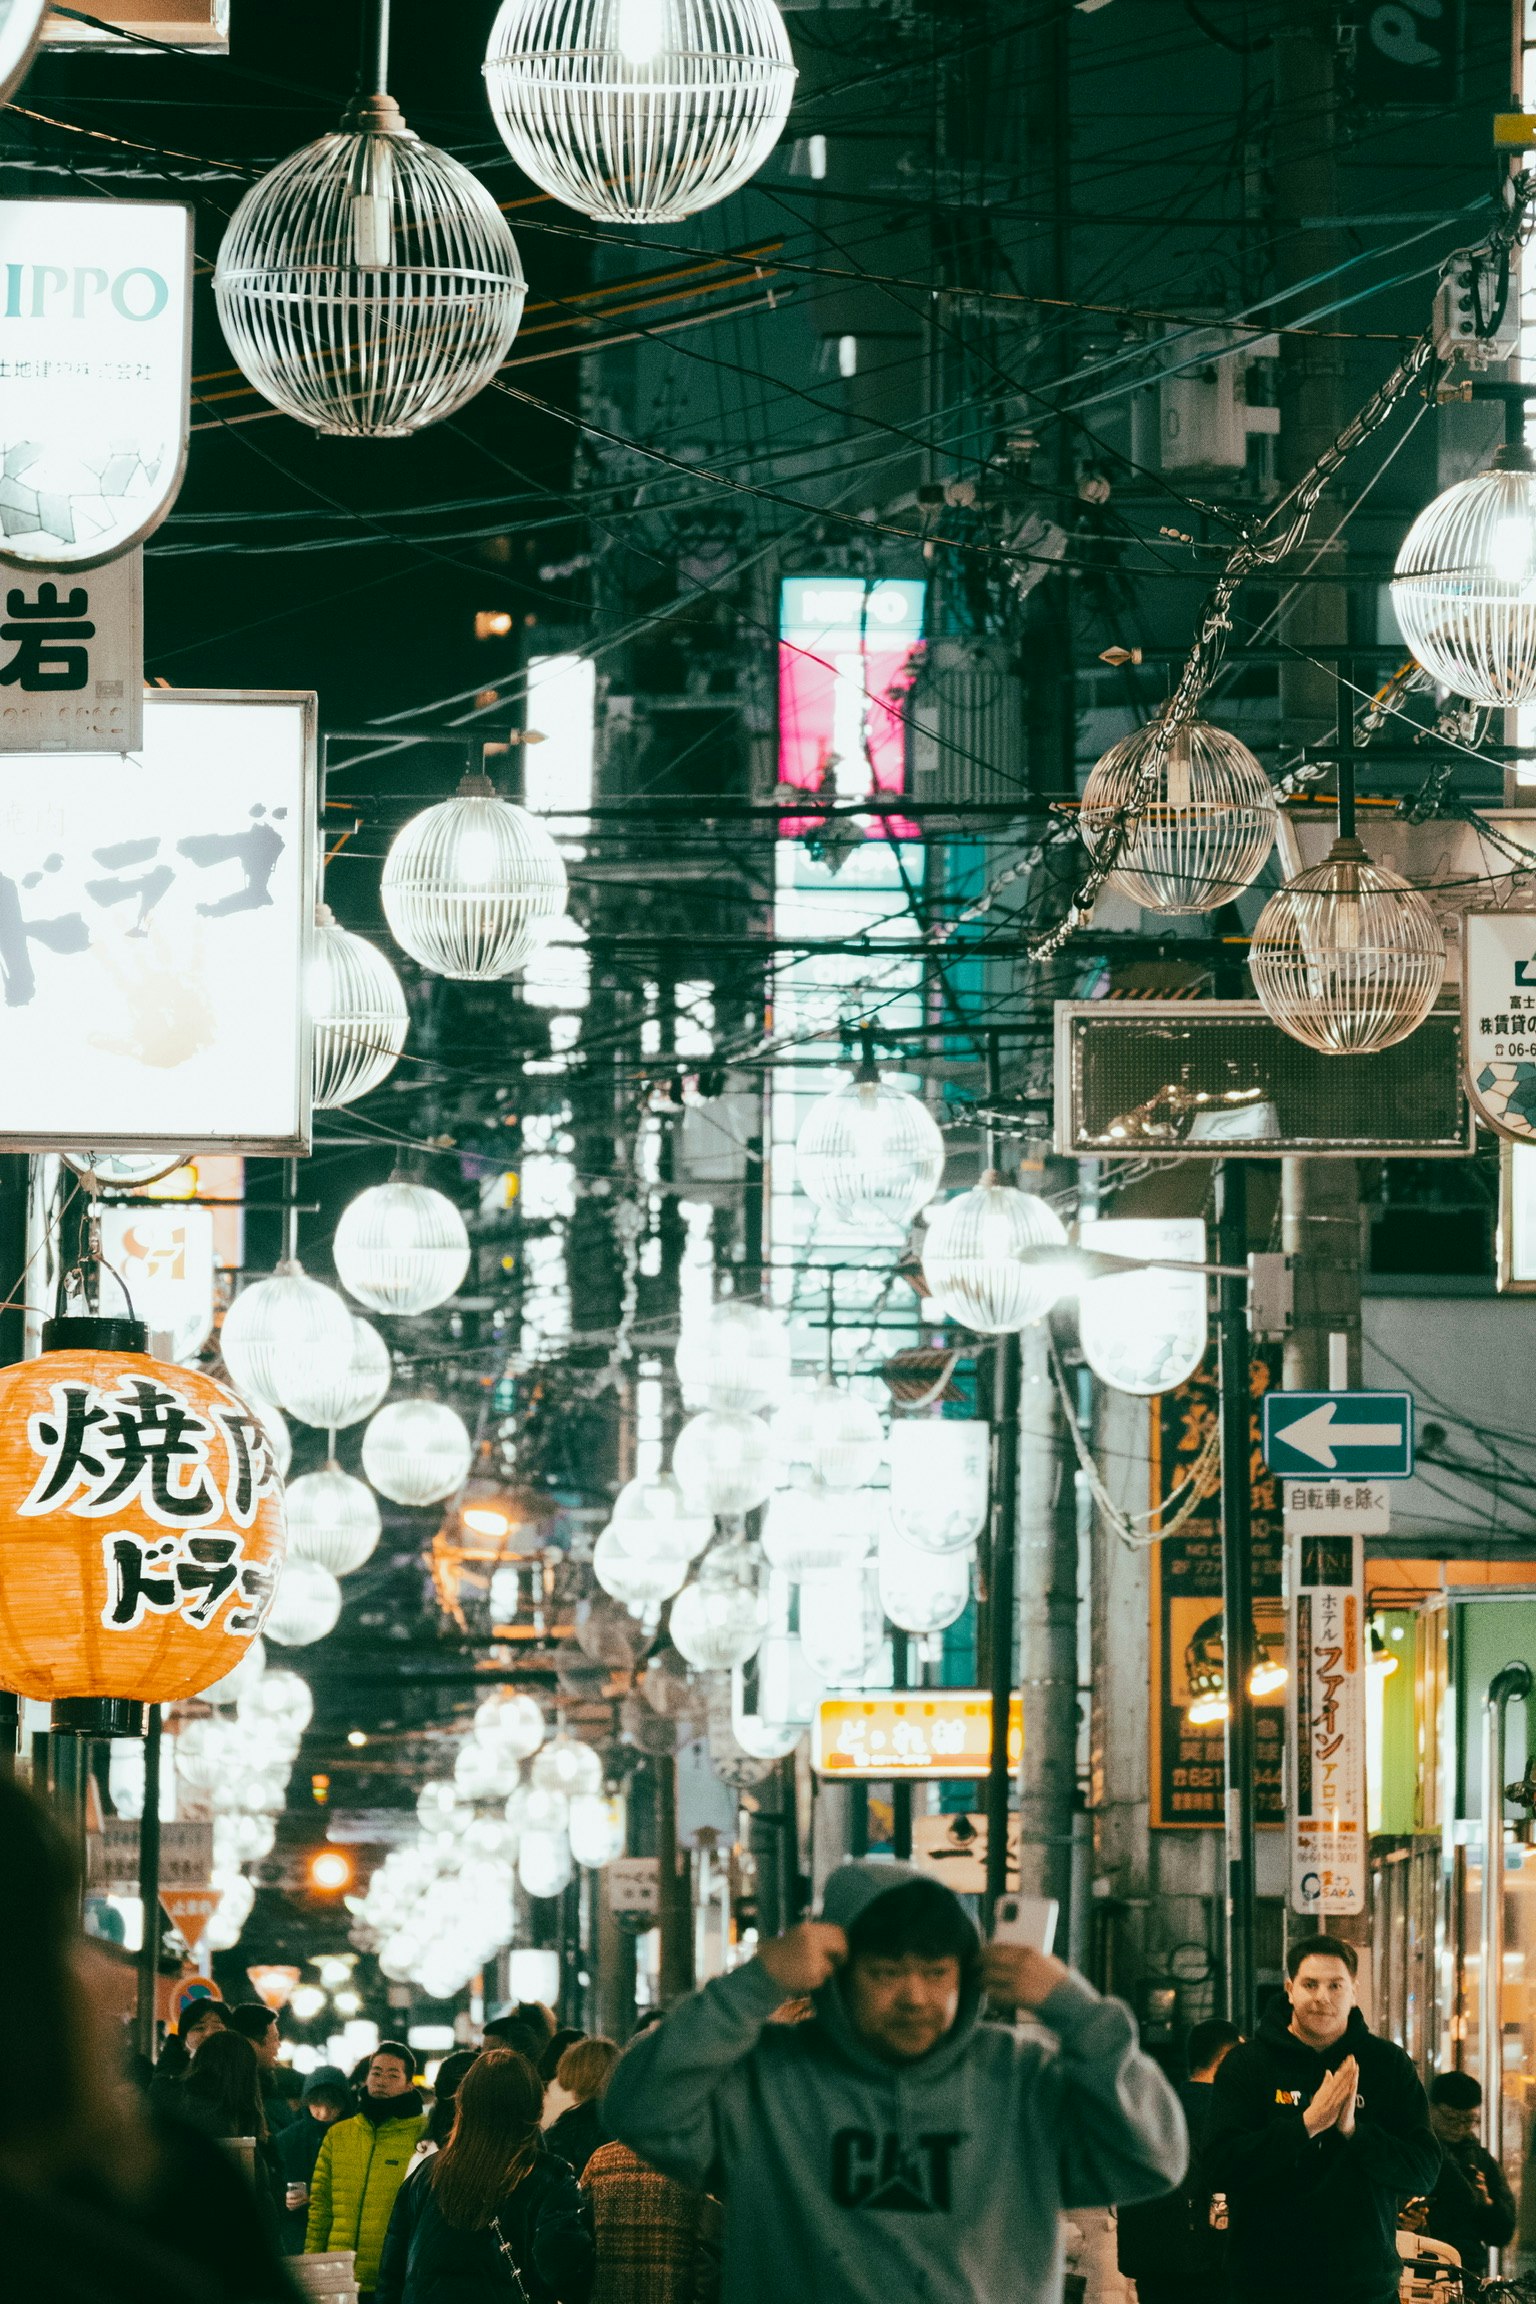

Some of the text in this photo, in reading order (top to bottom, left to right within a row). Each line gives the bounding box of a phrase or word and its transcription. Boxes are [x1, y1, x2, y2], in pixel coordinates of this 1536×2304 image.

[4, 263, 169, 322] IPPO
[0, 582, 96, 692] 岩
[1292, 1488, 1384, 1511] 自転車を除く
[1321, 1593, 1338, 1643] ホテル
[1314, 1646, 1345, 1761] ファイン
[831, 2128, 968, 2214] CAT
